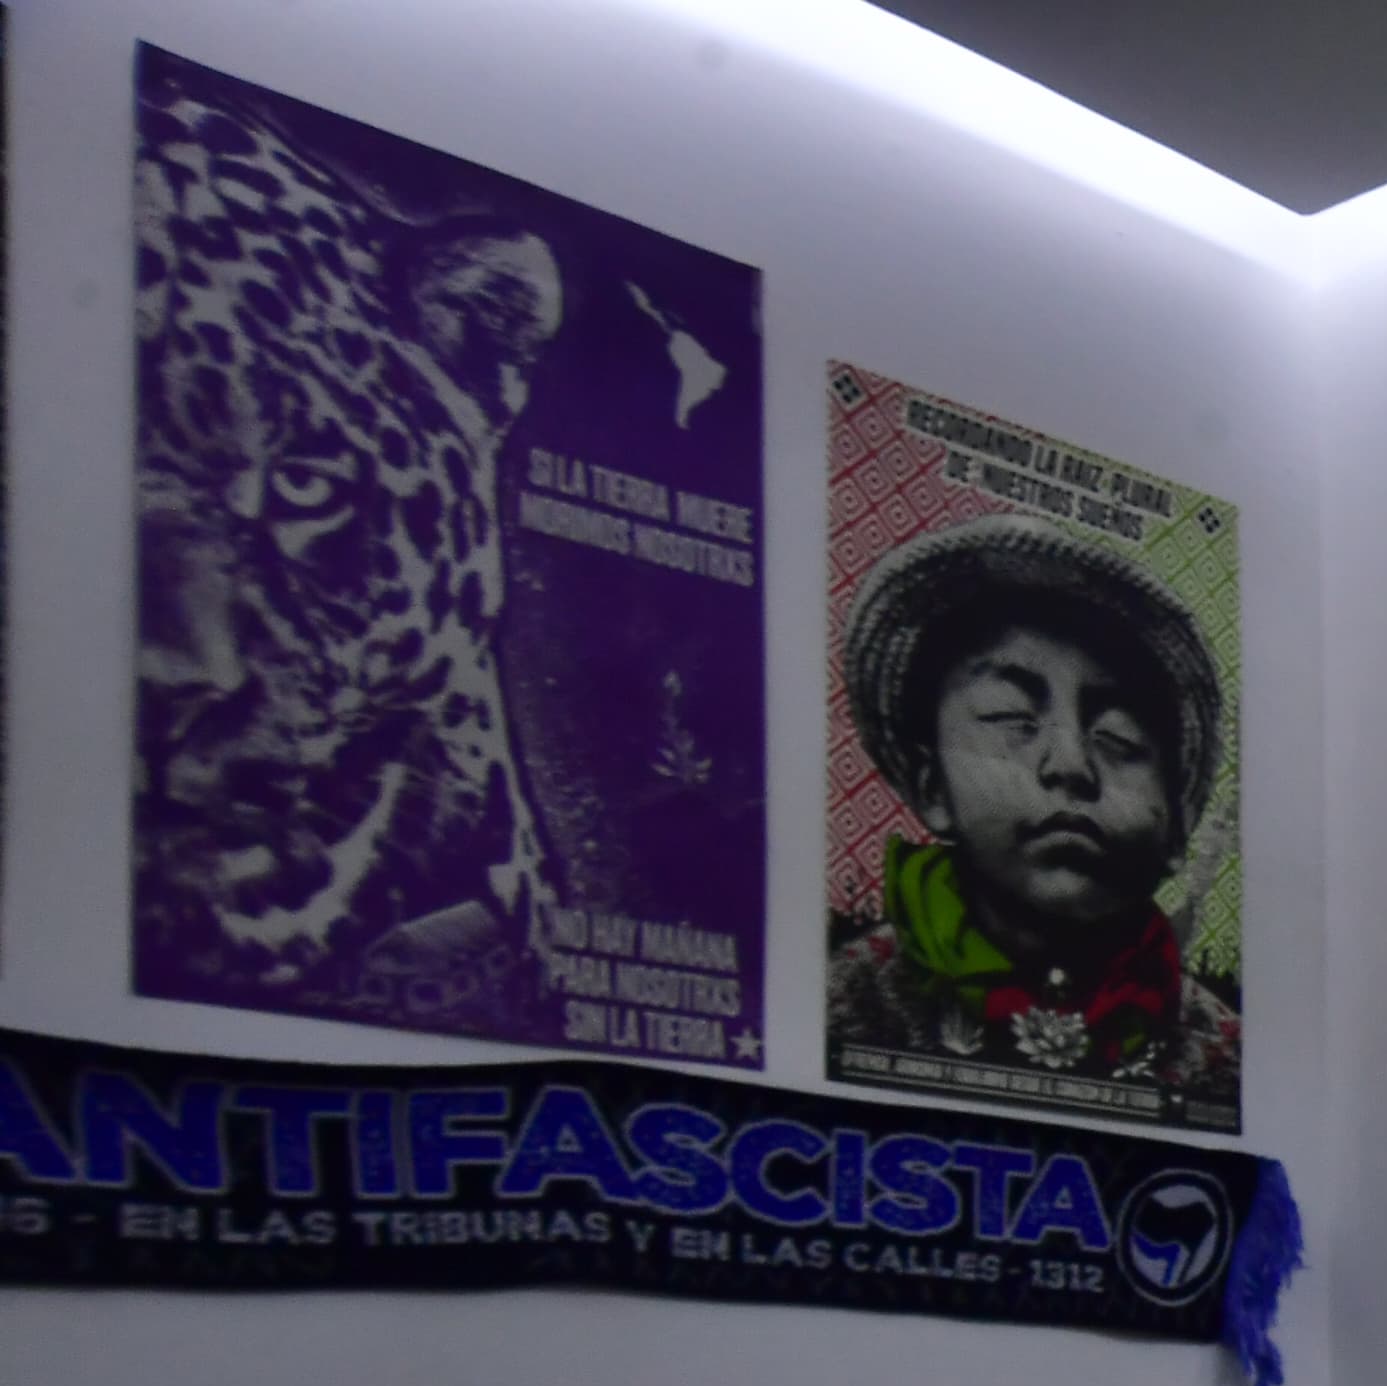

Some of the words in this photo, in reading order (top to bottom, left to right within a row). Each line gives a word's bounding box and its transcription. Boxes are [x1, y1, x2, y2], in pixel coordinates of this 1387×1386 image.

[558, 455, 588, 497] LA
[589, 464, 670, 522] TIERRA
[677, 491, 753, 544] MUERE
[983, 464, 1074, 517] NUESTROS
[610, 1005, 642, 1047] LA
[643, 1011, 727, 1061] TIERRA
[120, 1202, 199, 1240] EN
[218, 1206, 336, 1246] LAS
[353, 1210, 611, 1246] TRIBUNAS
[625, 1219, 655, 1252] Y
[670, 1227, 734, 1262] EN
[740, 1232, 832, 1270] LAS
[844, 1240, 999, 1280] CALLES
[1030, 1257, 1104, 1293] 1312
